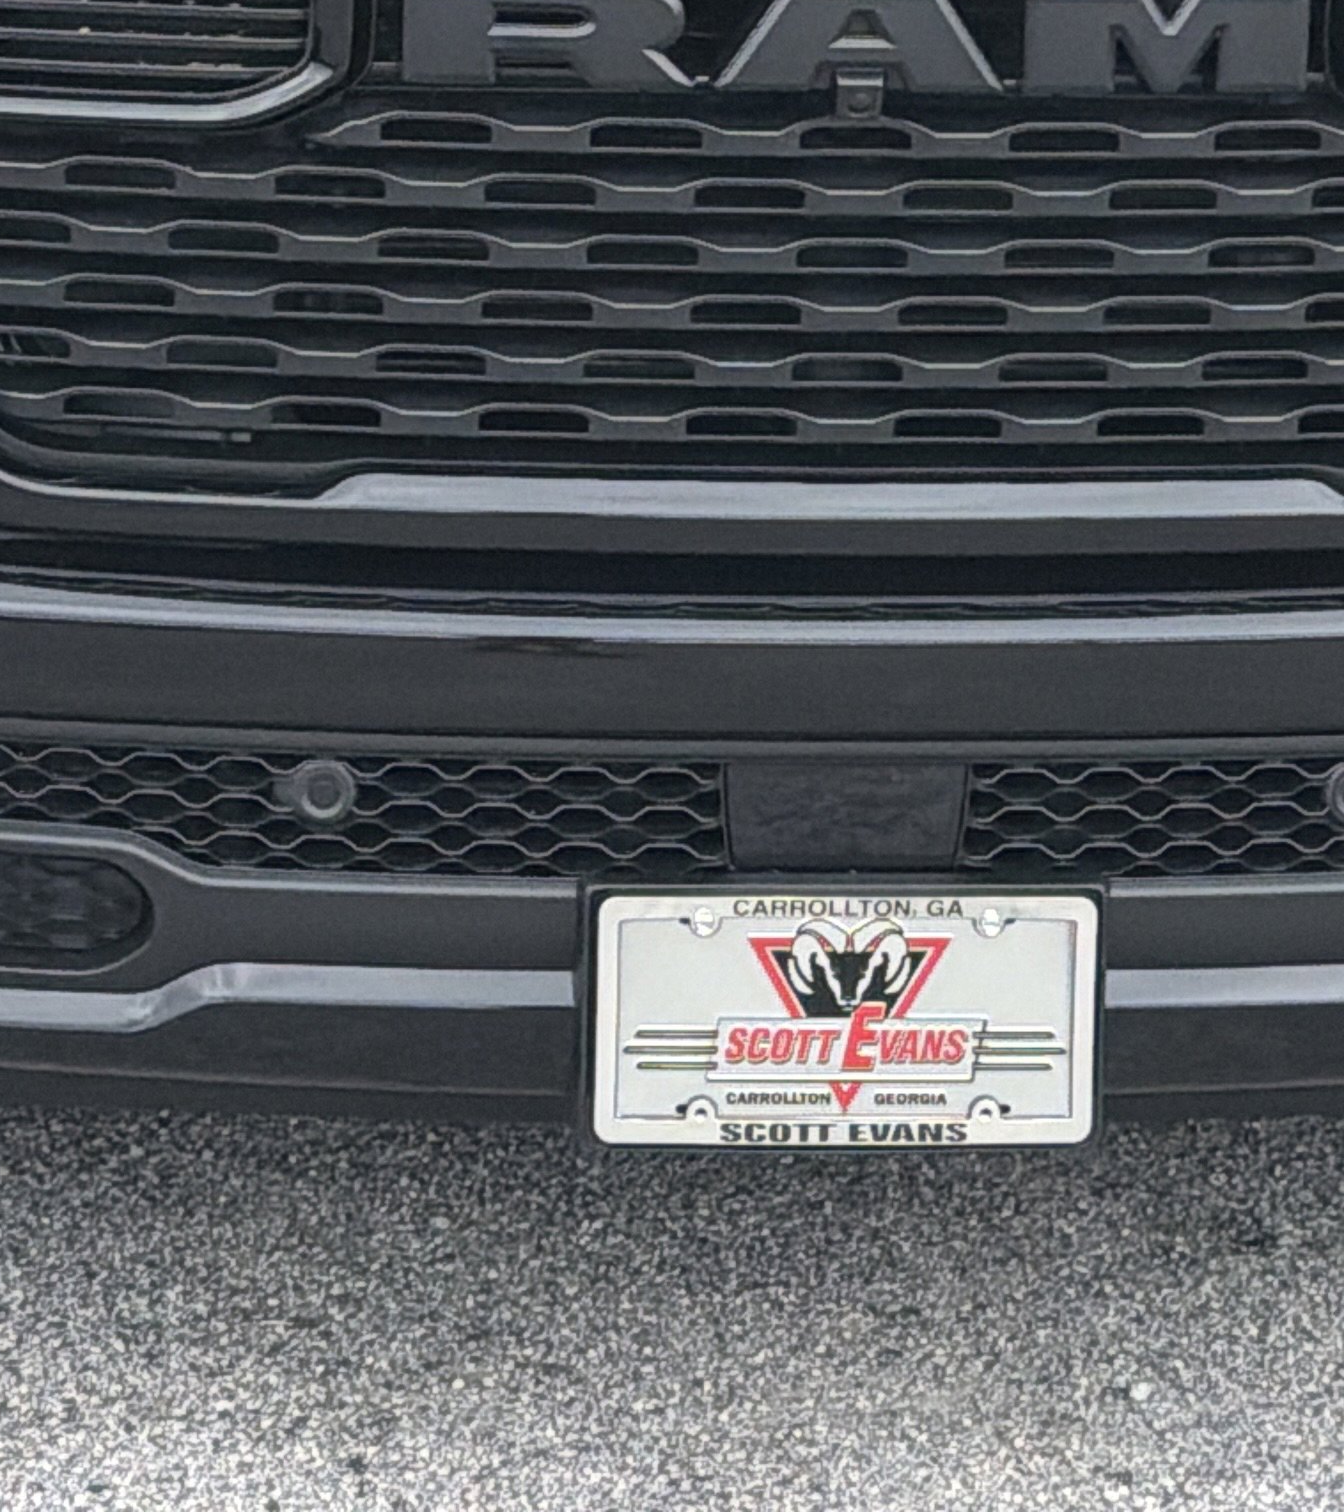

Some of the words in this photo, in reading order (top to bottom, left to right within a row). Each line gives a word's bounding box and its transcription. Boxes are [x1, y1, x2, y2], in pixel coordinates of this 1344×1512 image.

[732, 899, 918, 918] CARROLLTON,
[926, 899, 964, 917] GA
[724, 1028, 841, 1065] SCOTT
[840, 1001, 969, 1072] EVANS
[725, 1091, 831, 1106] CARROLLTON
[873, 1091, 947, 1106] GEORGIA
[719, 1123, 837, 1143] SCOTT
[848, 1123, 968, 1143] EVANS
